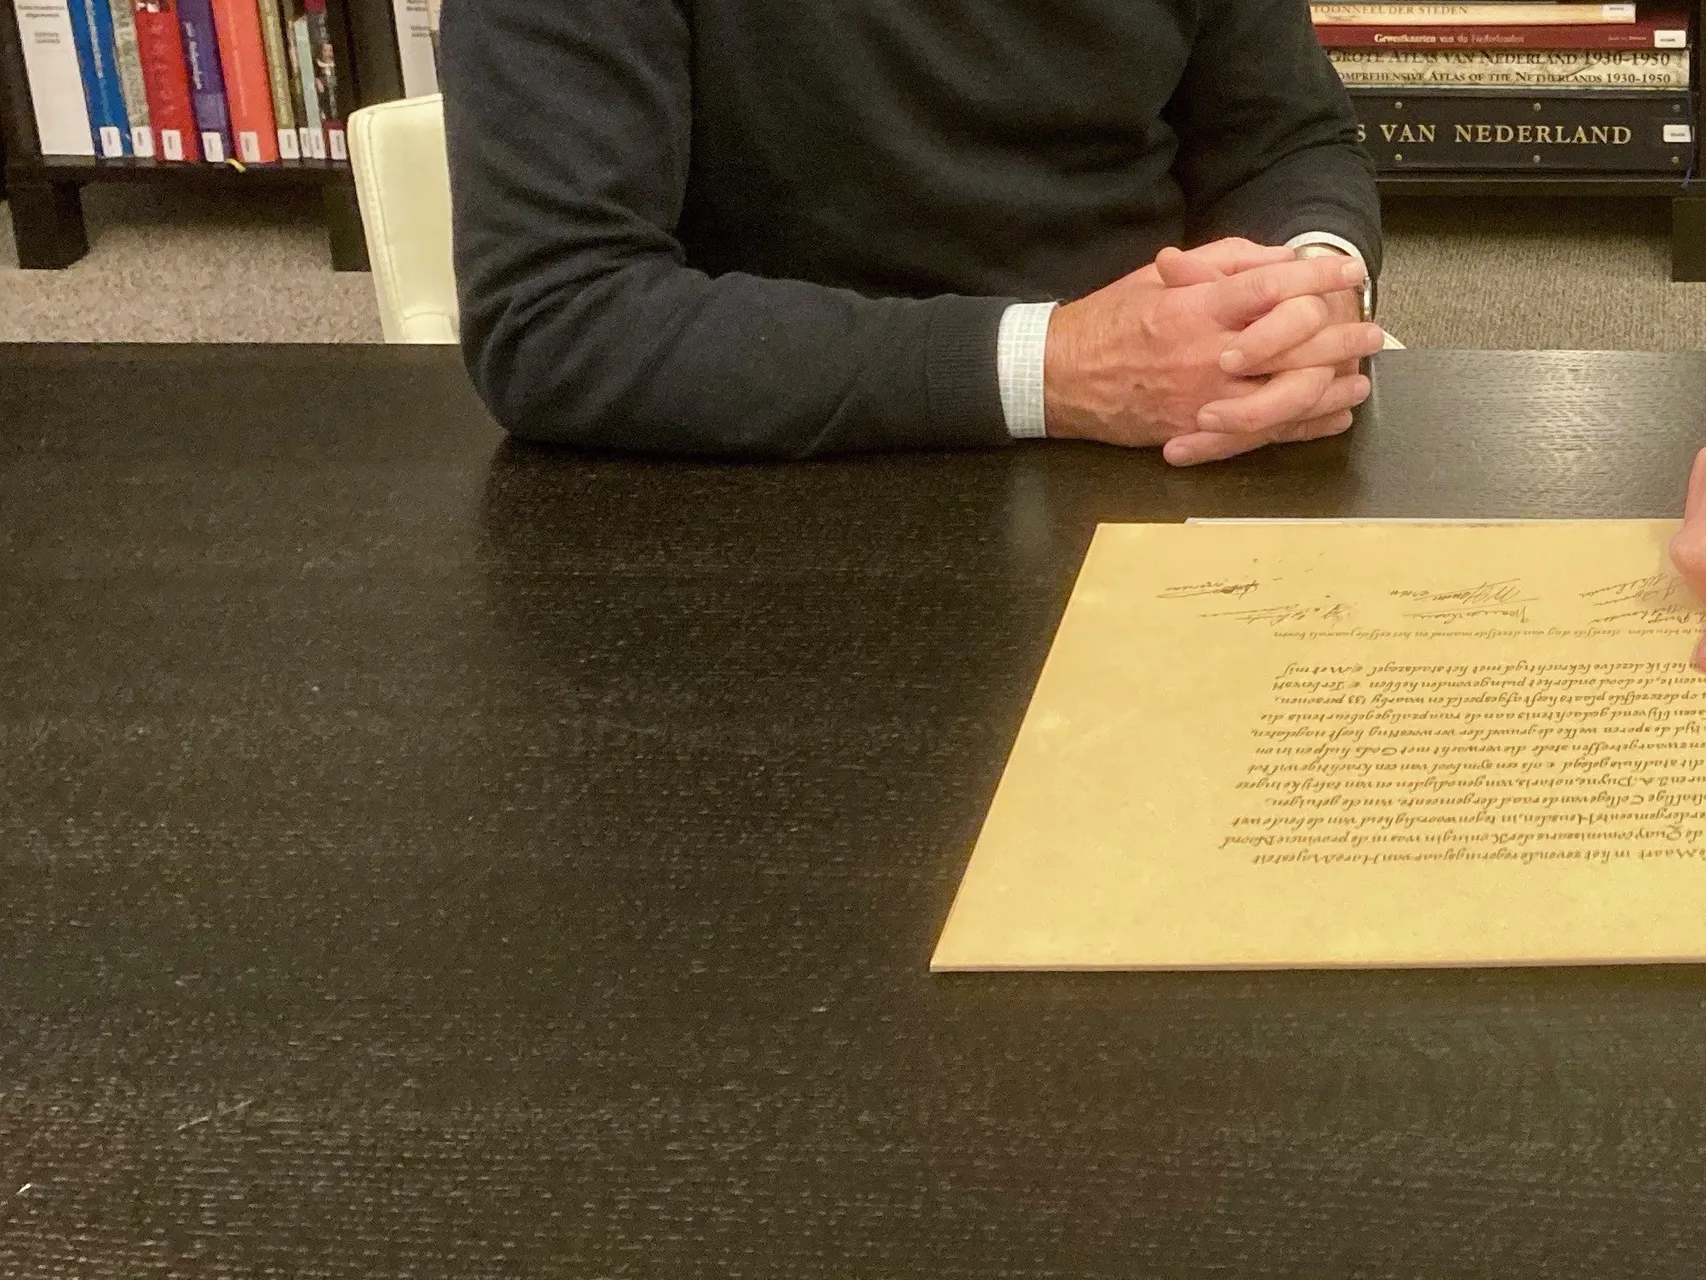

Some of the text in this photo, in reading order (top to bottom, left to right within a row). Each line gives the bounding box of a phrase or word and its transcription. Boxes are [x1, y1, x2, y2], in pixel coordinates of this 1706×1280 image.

[1584, 52, 1671, 67] 1930-1950
[1338, 72, 1424, 81] OMPREHENSIVE
[1469, 73, 1482, 82] OF
[1607, 73, 1671, 84] 1930-1950
[1380, 124, 1436, 142] VAN
[1455, 124, 1632, 144] NEDERLAND
